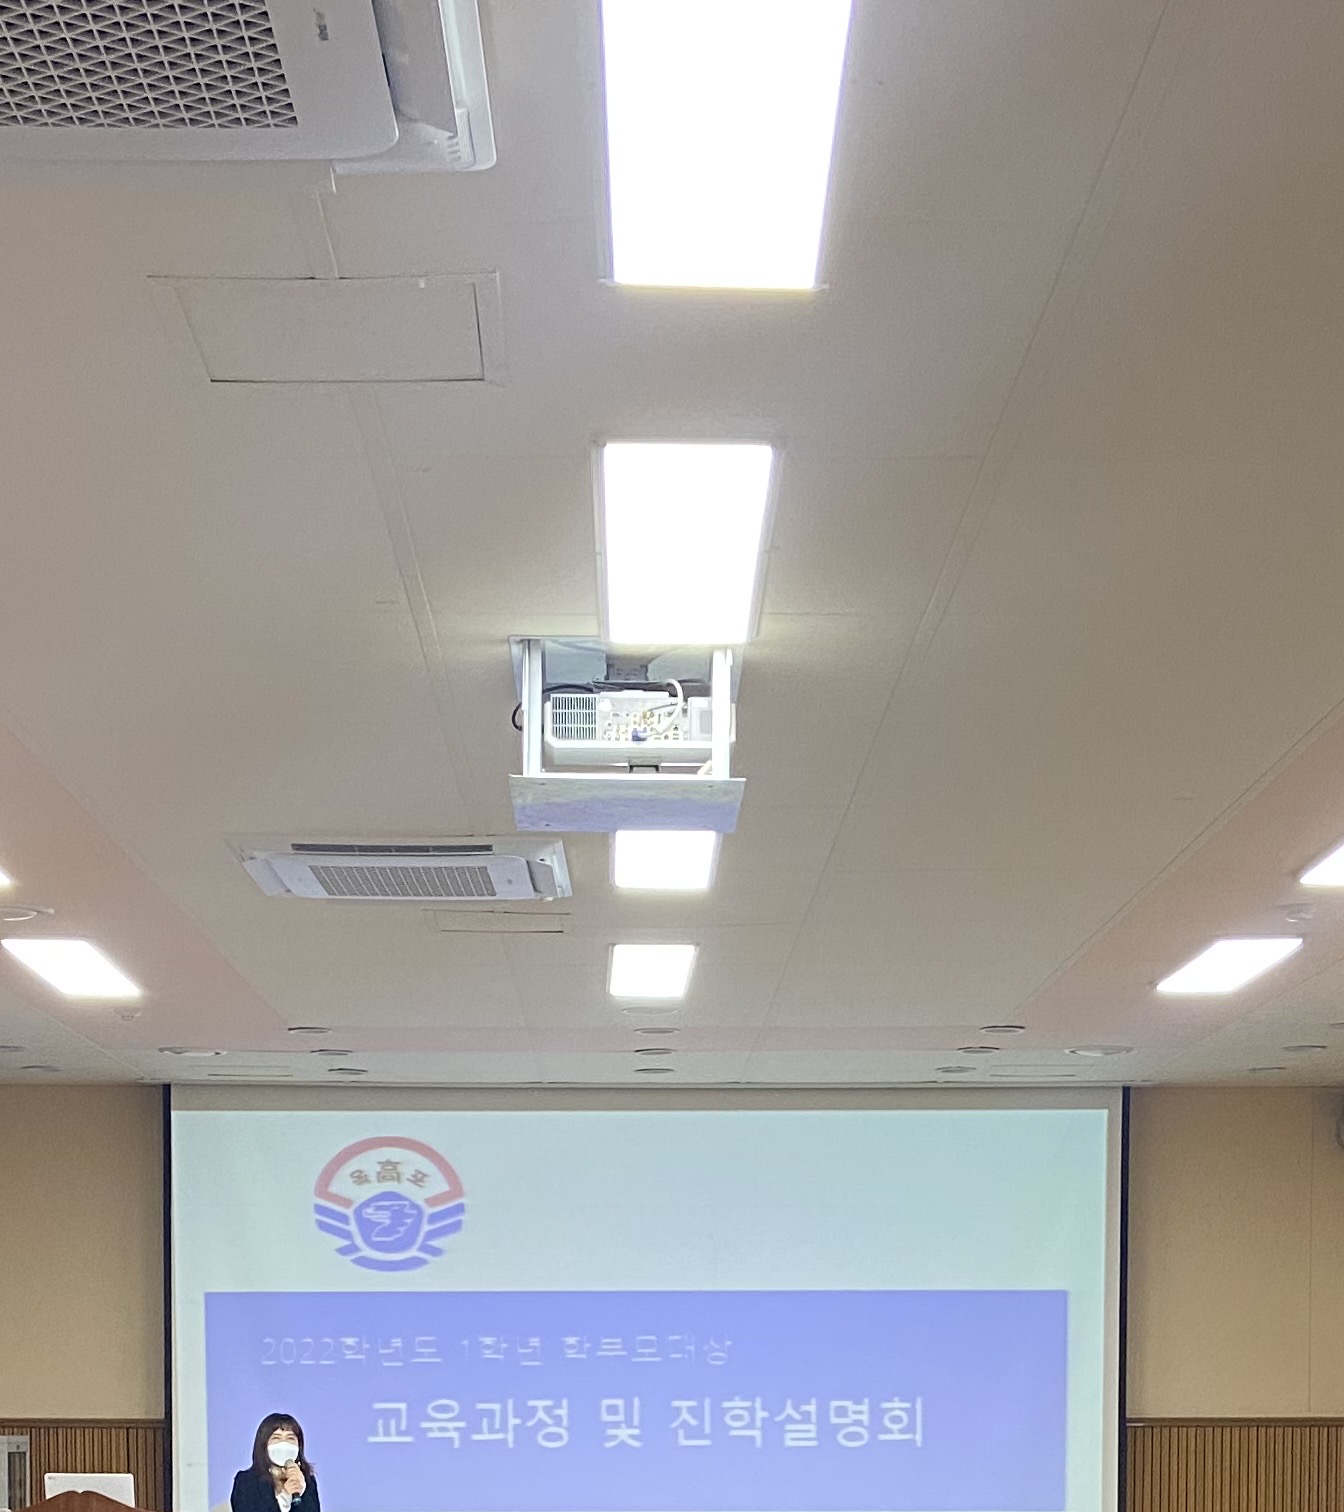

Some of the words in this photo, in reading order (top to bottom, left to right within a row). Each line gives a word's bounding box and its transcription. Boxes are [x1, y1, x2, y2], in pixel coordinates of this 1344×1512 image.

[260, 1335, 444, 1367] 2022학년도
[460, 1335, 545, 1367] 1학년
[366, 1397, 571, 1448] 교육과정
[599, 1397, 644, 1448] 및
[669, 1397, 925, 1448] 진학설명회
